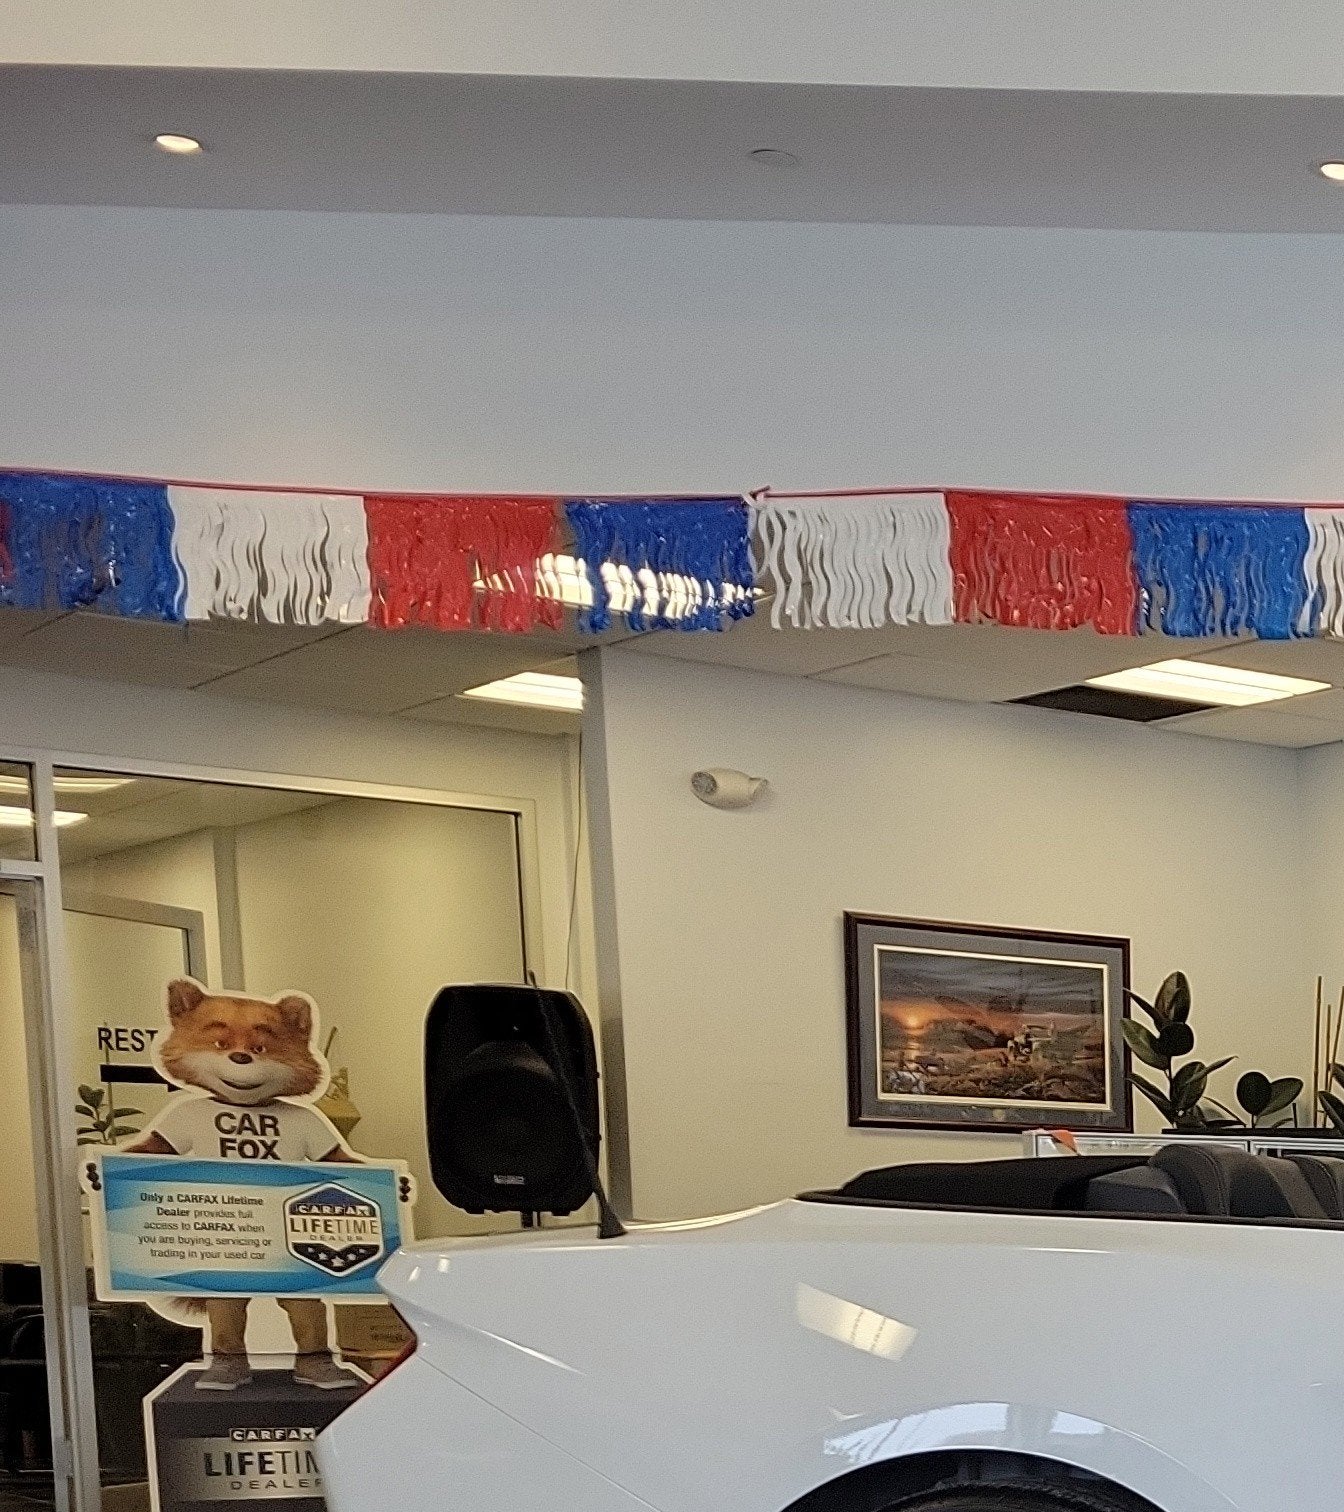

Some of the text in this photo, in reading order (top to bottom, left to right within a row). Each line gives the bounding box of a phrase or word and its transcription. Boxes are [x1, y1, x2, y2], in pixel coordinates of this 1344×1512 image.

[214, 1111, 281, 1136] CAR
[219, 1137, 281, 1160] FOX
[140, 1192, 163, 1203] Only
[177, 1193, 218, 1204] CARFAX
[222, 1195, 263, 1205] Lifetime
[156, 1207, 190, 1216] Dealer
[297, 1204, 371, 1216] CARFAX
[143, 1221, 179, 1230] access
[194, 1221, 236, 1232] CARFAX
[238, 1223, 265, 1232] when
[290, 1217, 380, 1235] LIFETIME
[138, 1235, 156, 1245] you
[150, 1248, 266, 1261] trading in your used car
[231, 1428, 316, 1441] CARFAX
